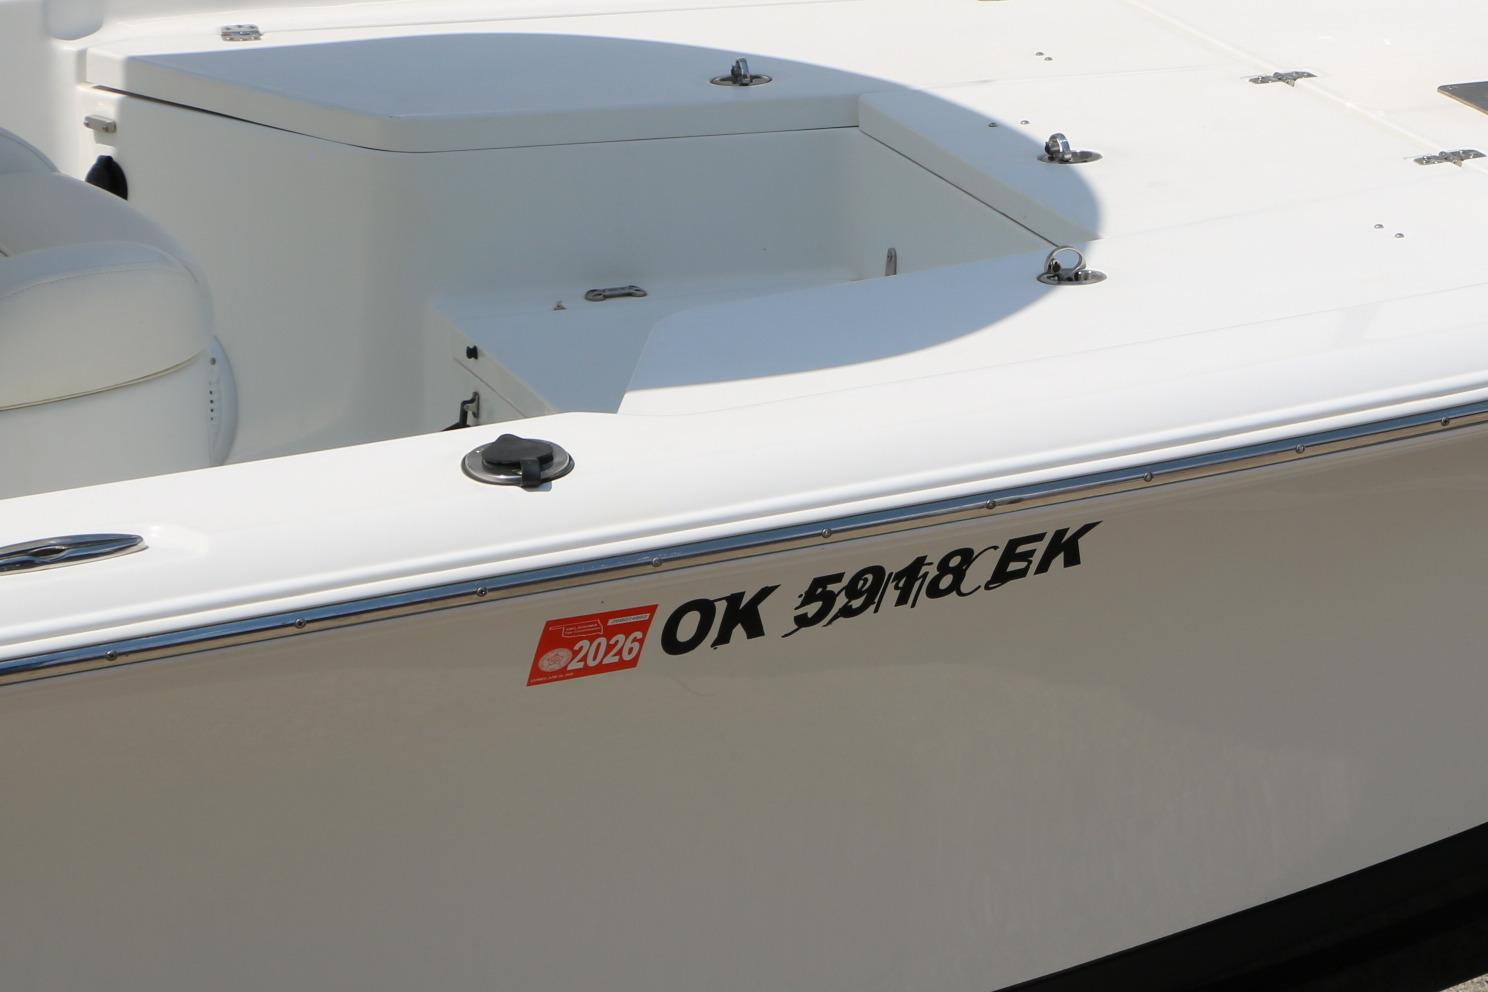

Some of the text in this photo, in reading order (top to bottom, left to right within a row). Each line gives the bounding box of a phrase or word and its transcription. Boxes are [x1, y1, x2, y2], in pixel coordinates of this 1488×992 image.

[661, 521, 1103, 656] OK 5918 EK
[567, 631, 643, 671] 2026
